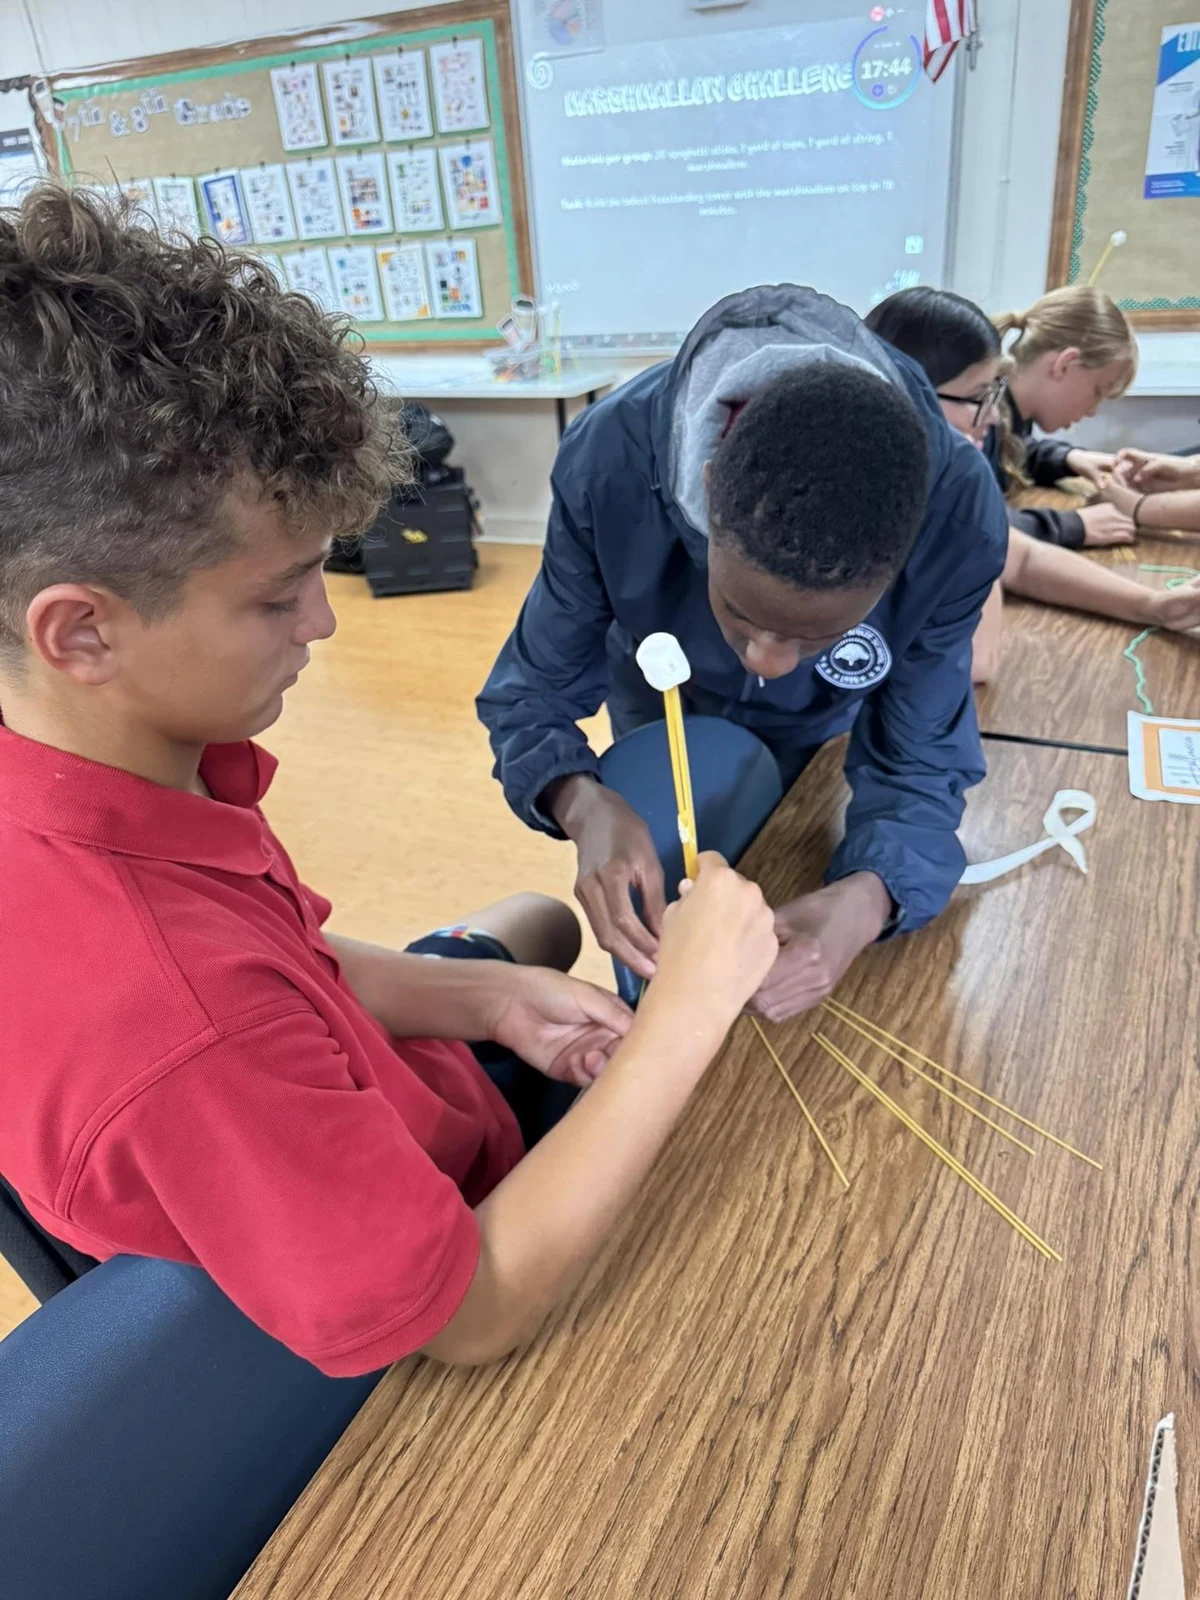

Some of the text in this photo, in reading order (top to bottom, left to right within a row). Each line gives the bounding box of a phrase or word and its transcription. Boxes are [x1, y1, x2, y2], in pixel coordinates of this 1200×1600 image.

[727, 62, 853, 101] CHALLENG
[861, 57, 912, 80] 17:44
[109, 110, 131, 137] &
